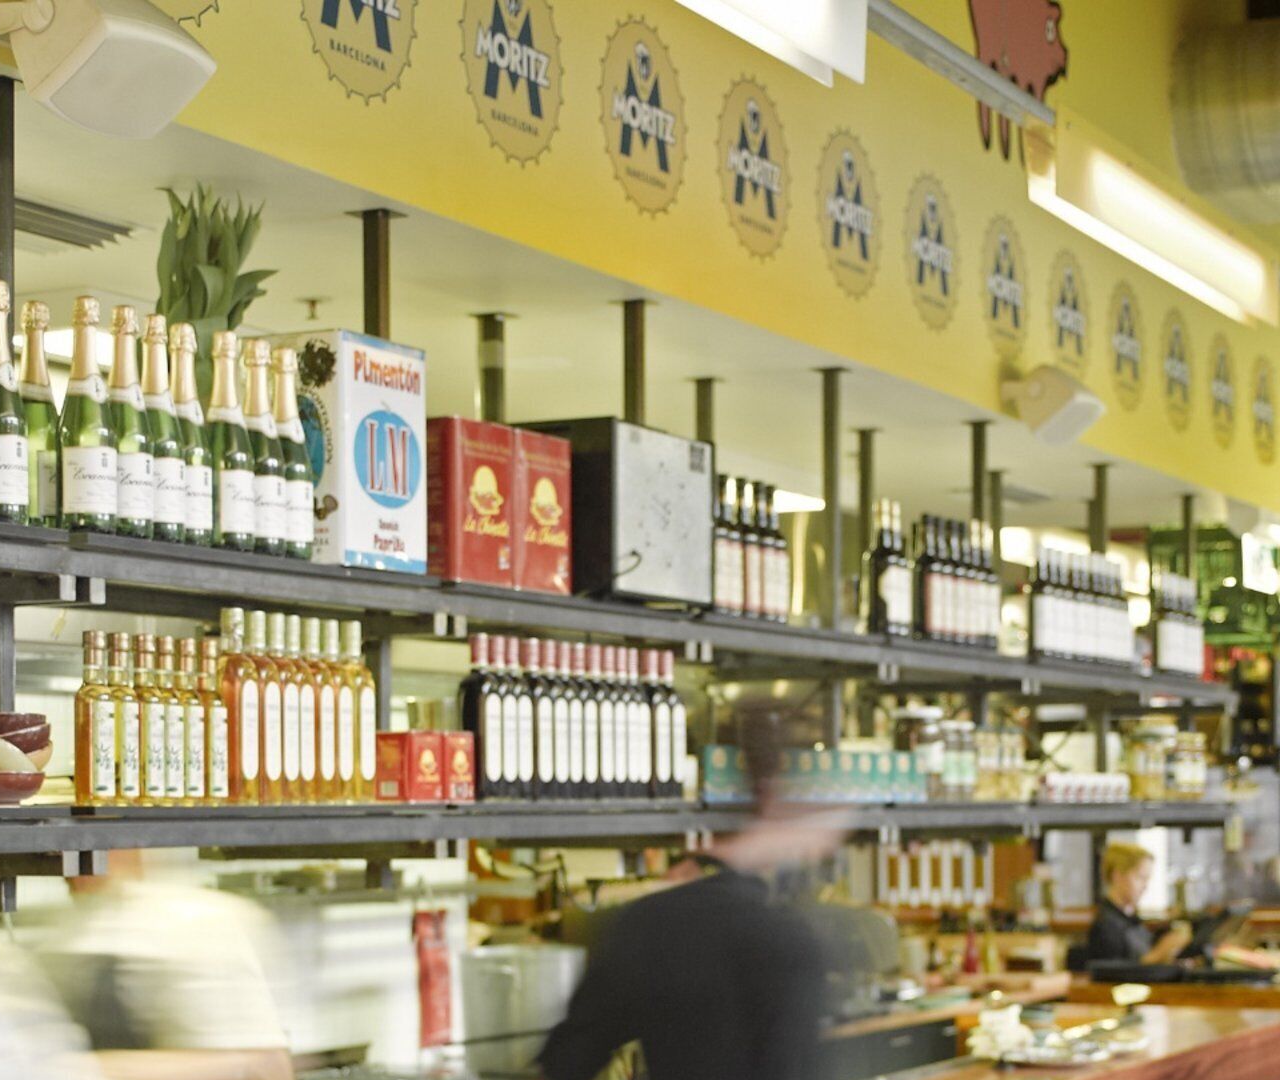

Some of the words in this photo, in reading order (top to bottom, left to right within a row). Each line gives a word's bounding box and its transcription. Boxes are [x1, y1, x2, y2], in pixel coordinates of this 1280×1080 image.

[329, 38, 386, 71] BARCELONA
[475, 20, 550, 89] MORITZ
[491, 109, 540, 137] BARCELONA
[611, 86, 676, 145] MORITZ
[728, 140, 782, 196] MORITZ
[366, 419, 410, 498] LM
